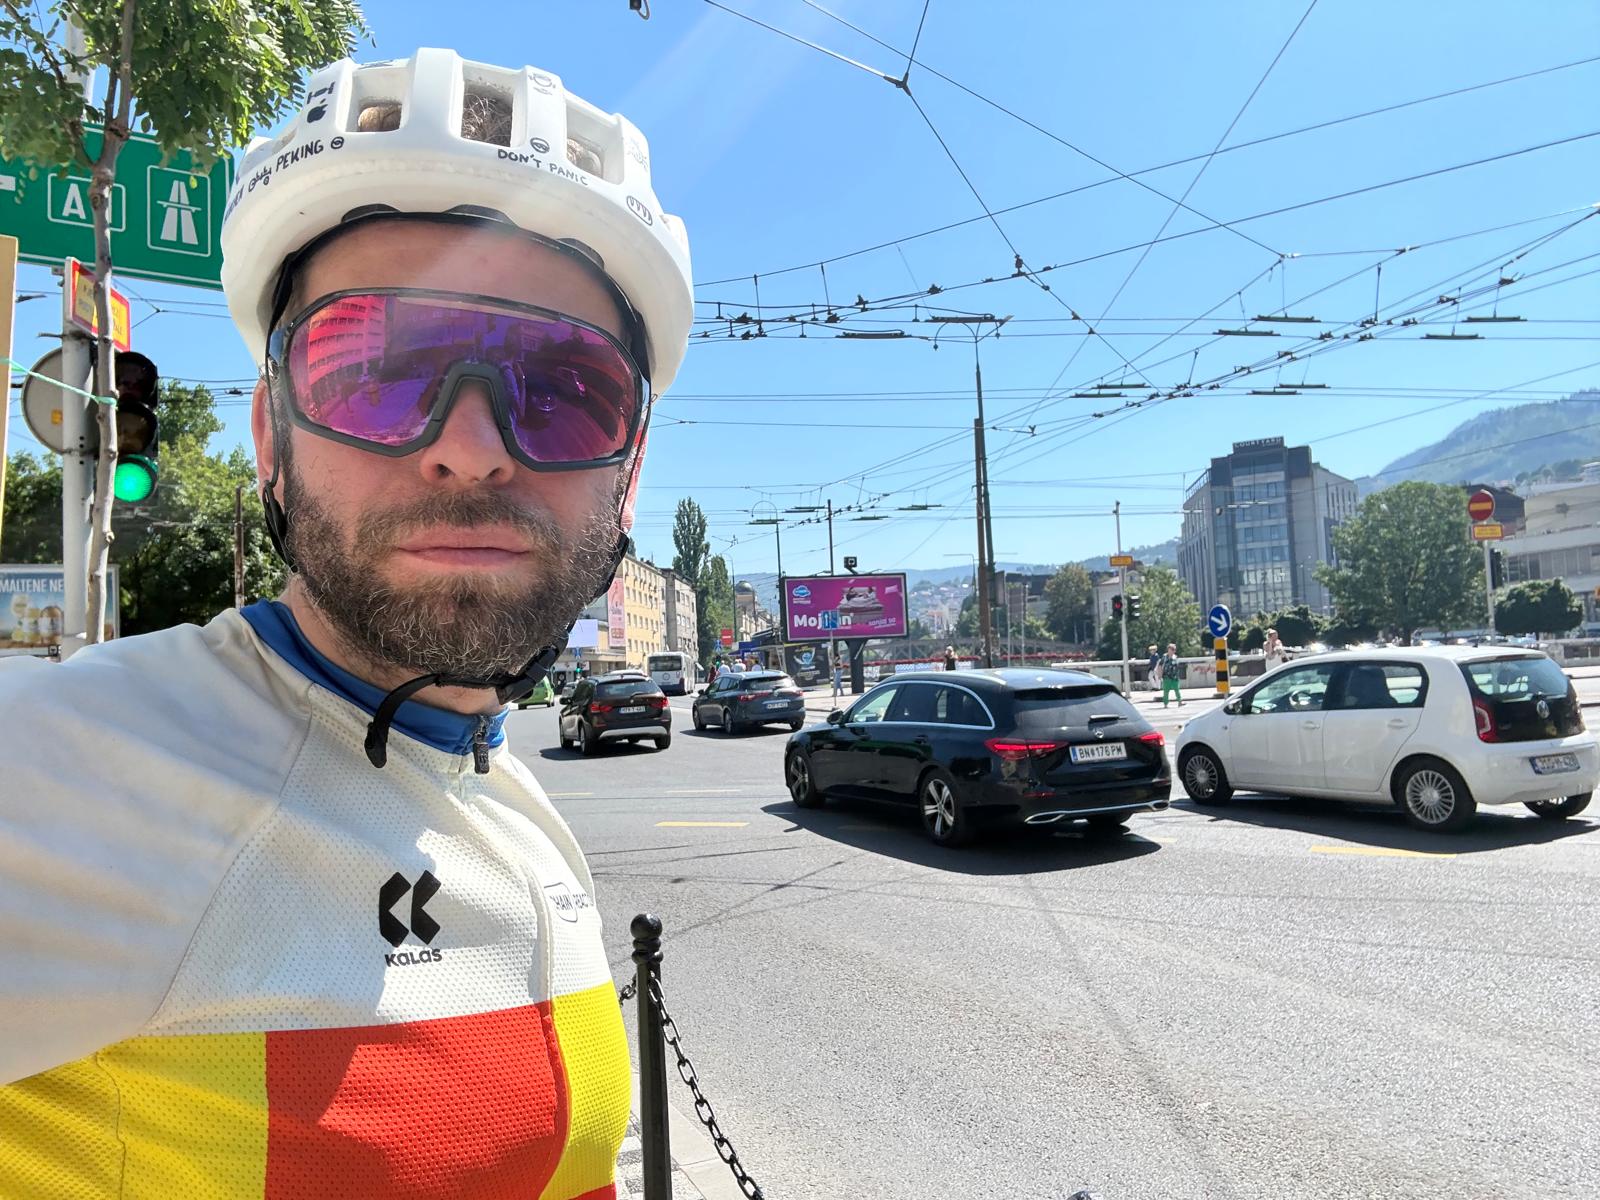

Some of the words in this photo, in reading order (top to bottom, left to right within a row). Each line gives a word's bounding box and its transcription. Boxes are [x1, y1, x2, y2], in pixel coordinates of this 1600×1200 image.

[275, 139, 324, 173] PEKING
[497, 148, 542, 169] DON'T
[549, 162, 588, 186] PANIC
[793, 613, 822, 630] Moj
